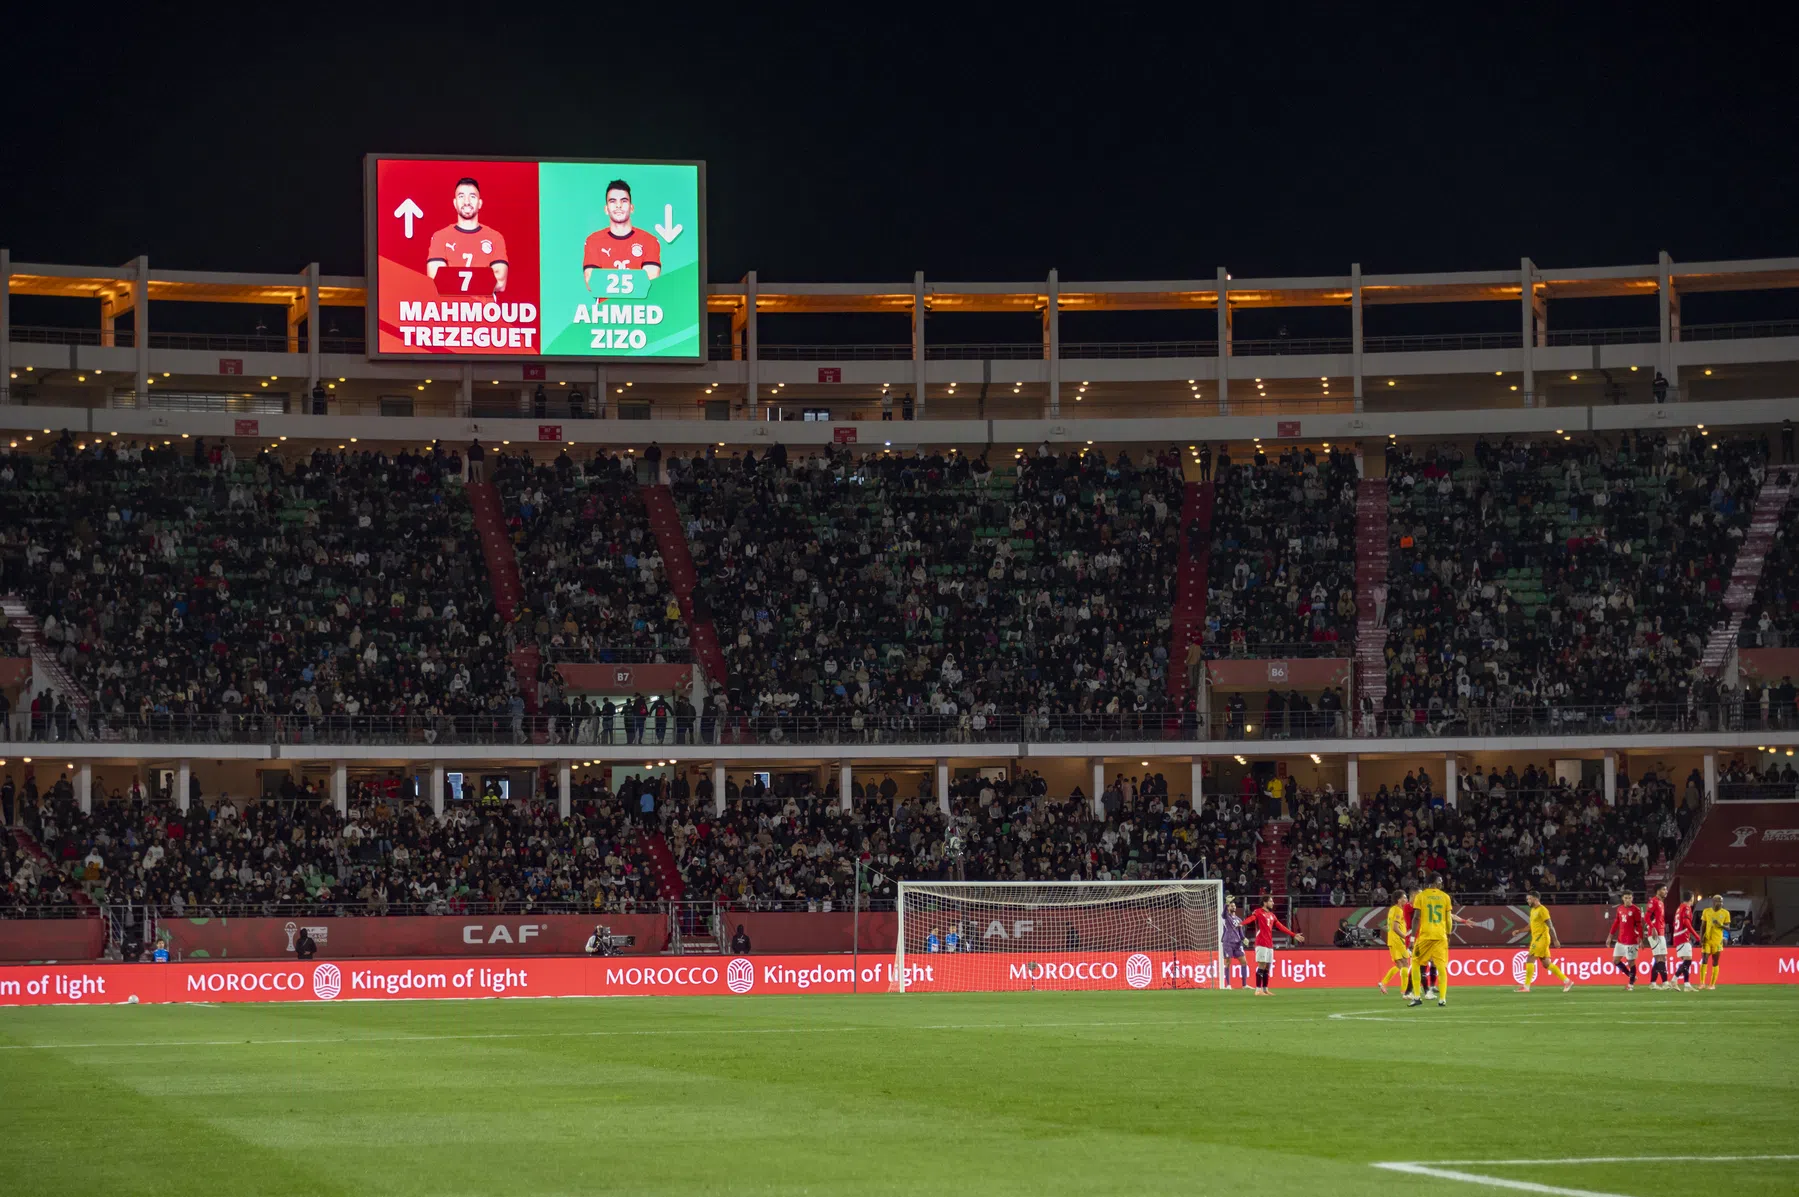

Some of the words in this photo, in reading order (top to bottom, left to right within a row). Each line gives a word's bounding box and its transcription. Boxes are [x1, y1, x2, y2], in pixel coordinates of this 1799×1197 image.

[458, 271, 473, 291] 7
[606, 273, 634, 294] 25
[400, 301, 537, 323] MAHMOUD
[573, 304, 664, 325] AHMED
[400, 326, 537, 348] TREZEGUET
[590, 329, 647, 349] ZIZO
[617, 672, 630, 682] B7
[1271, 668, 1285, 677] B6
[1427, 904, 1443, 923] 15
[606, 967, 719, 985] MOROCCO
[764, 964, 855, 988] Kingdom
[861, 963, 882, 983] of
[887, 962, 934, 987] light
[1009, 961, 1118, 980] MOROCCO
[1162, 960, 1250, 984] Kingdm
[1281, 959, 1327, 983] light
[1778, 957, 1799, 974] M
[27, 975, 50, 995] of
[55, 975, 106, 999] light
[187, 972, 305, 992] MOROCCO
[351, 970, 446, 994] Kingdom
[452, 968, 474, 988] of
[479, 968, 528, 992] light
